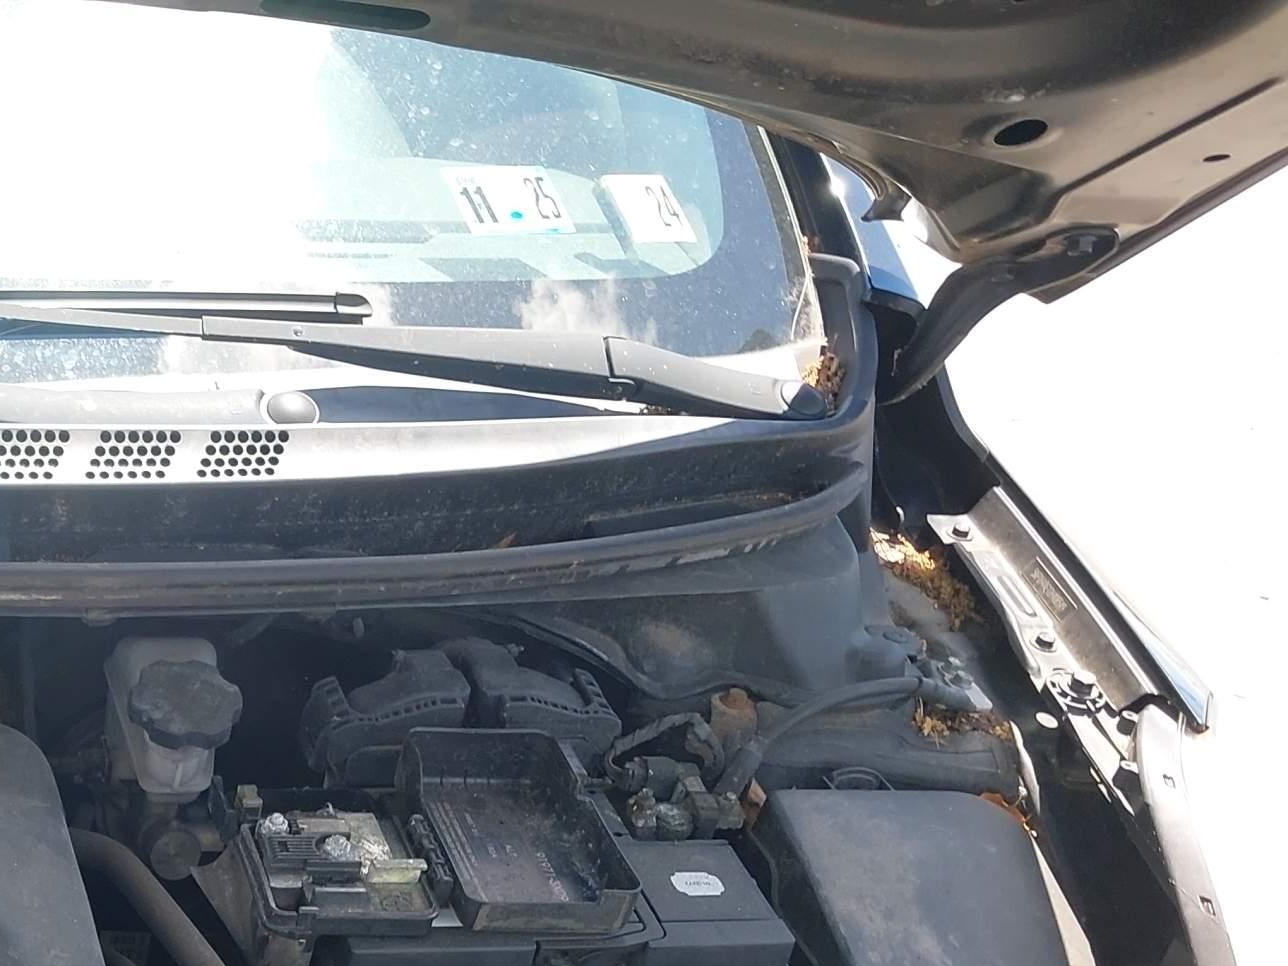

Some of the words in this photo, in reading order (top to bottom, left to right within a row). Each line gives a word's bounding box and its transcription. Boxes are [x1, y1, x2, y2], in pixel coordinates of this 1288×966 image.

[459, 186, 499, 224] 11
[523, 176, 563, 220] 25
[644, 185, 681, 228] 24
